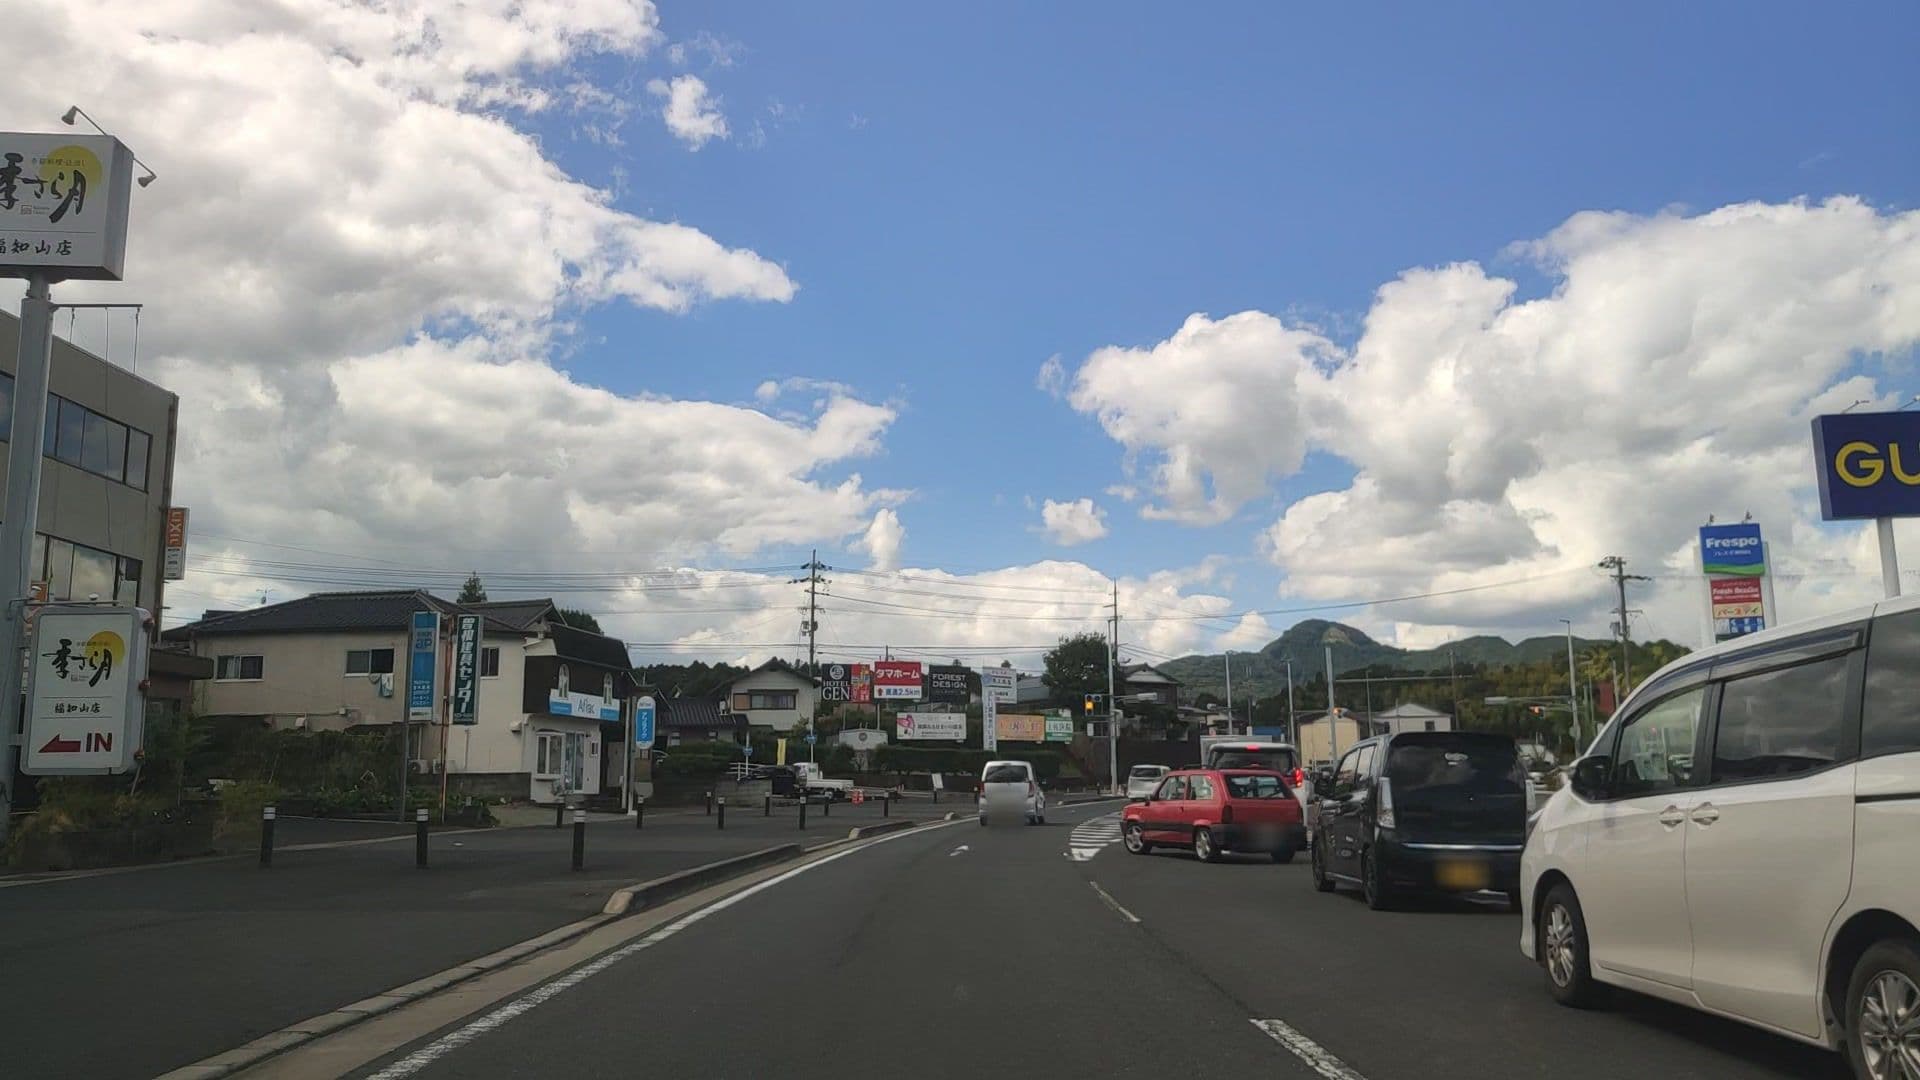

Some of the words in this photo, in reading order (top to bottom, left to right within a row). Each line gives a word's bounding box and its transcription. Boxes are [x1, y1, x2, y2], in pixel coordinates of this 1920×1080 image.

[1705, 537, 1759, 549] Frespo
[875, 668, 920, 679] タマホーム
[932, 673, 966, 681] FOREST
[932, 681, 967, 689] DESIGN
[822, 687, 850, 700] GEN
[54, 703, 101, 714] 福知山店
[577, 698, 595, 714] Aflac
[86, 732, 113, 752] IN
